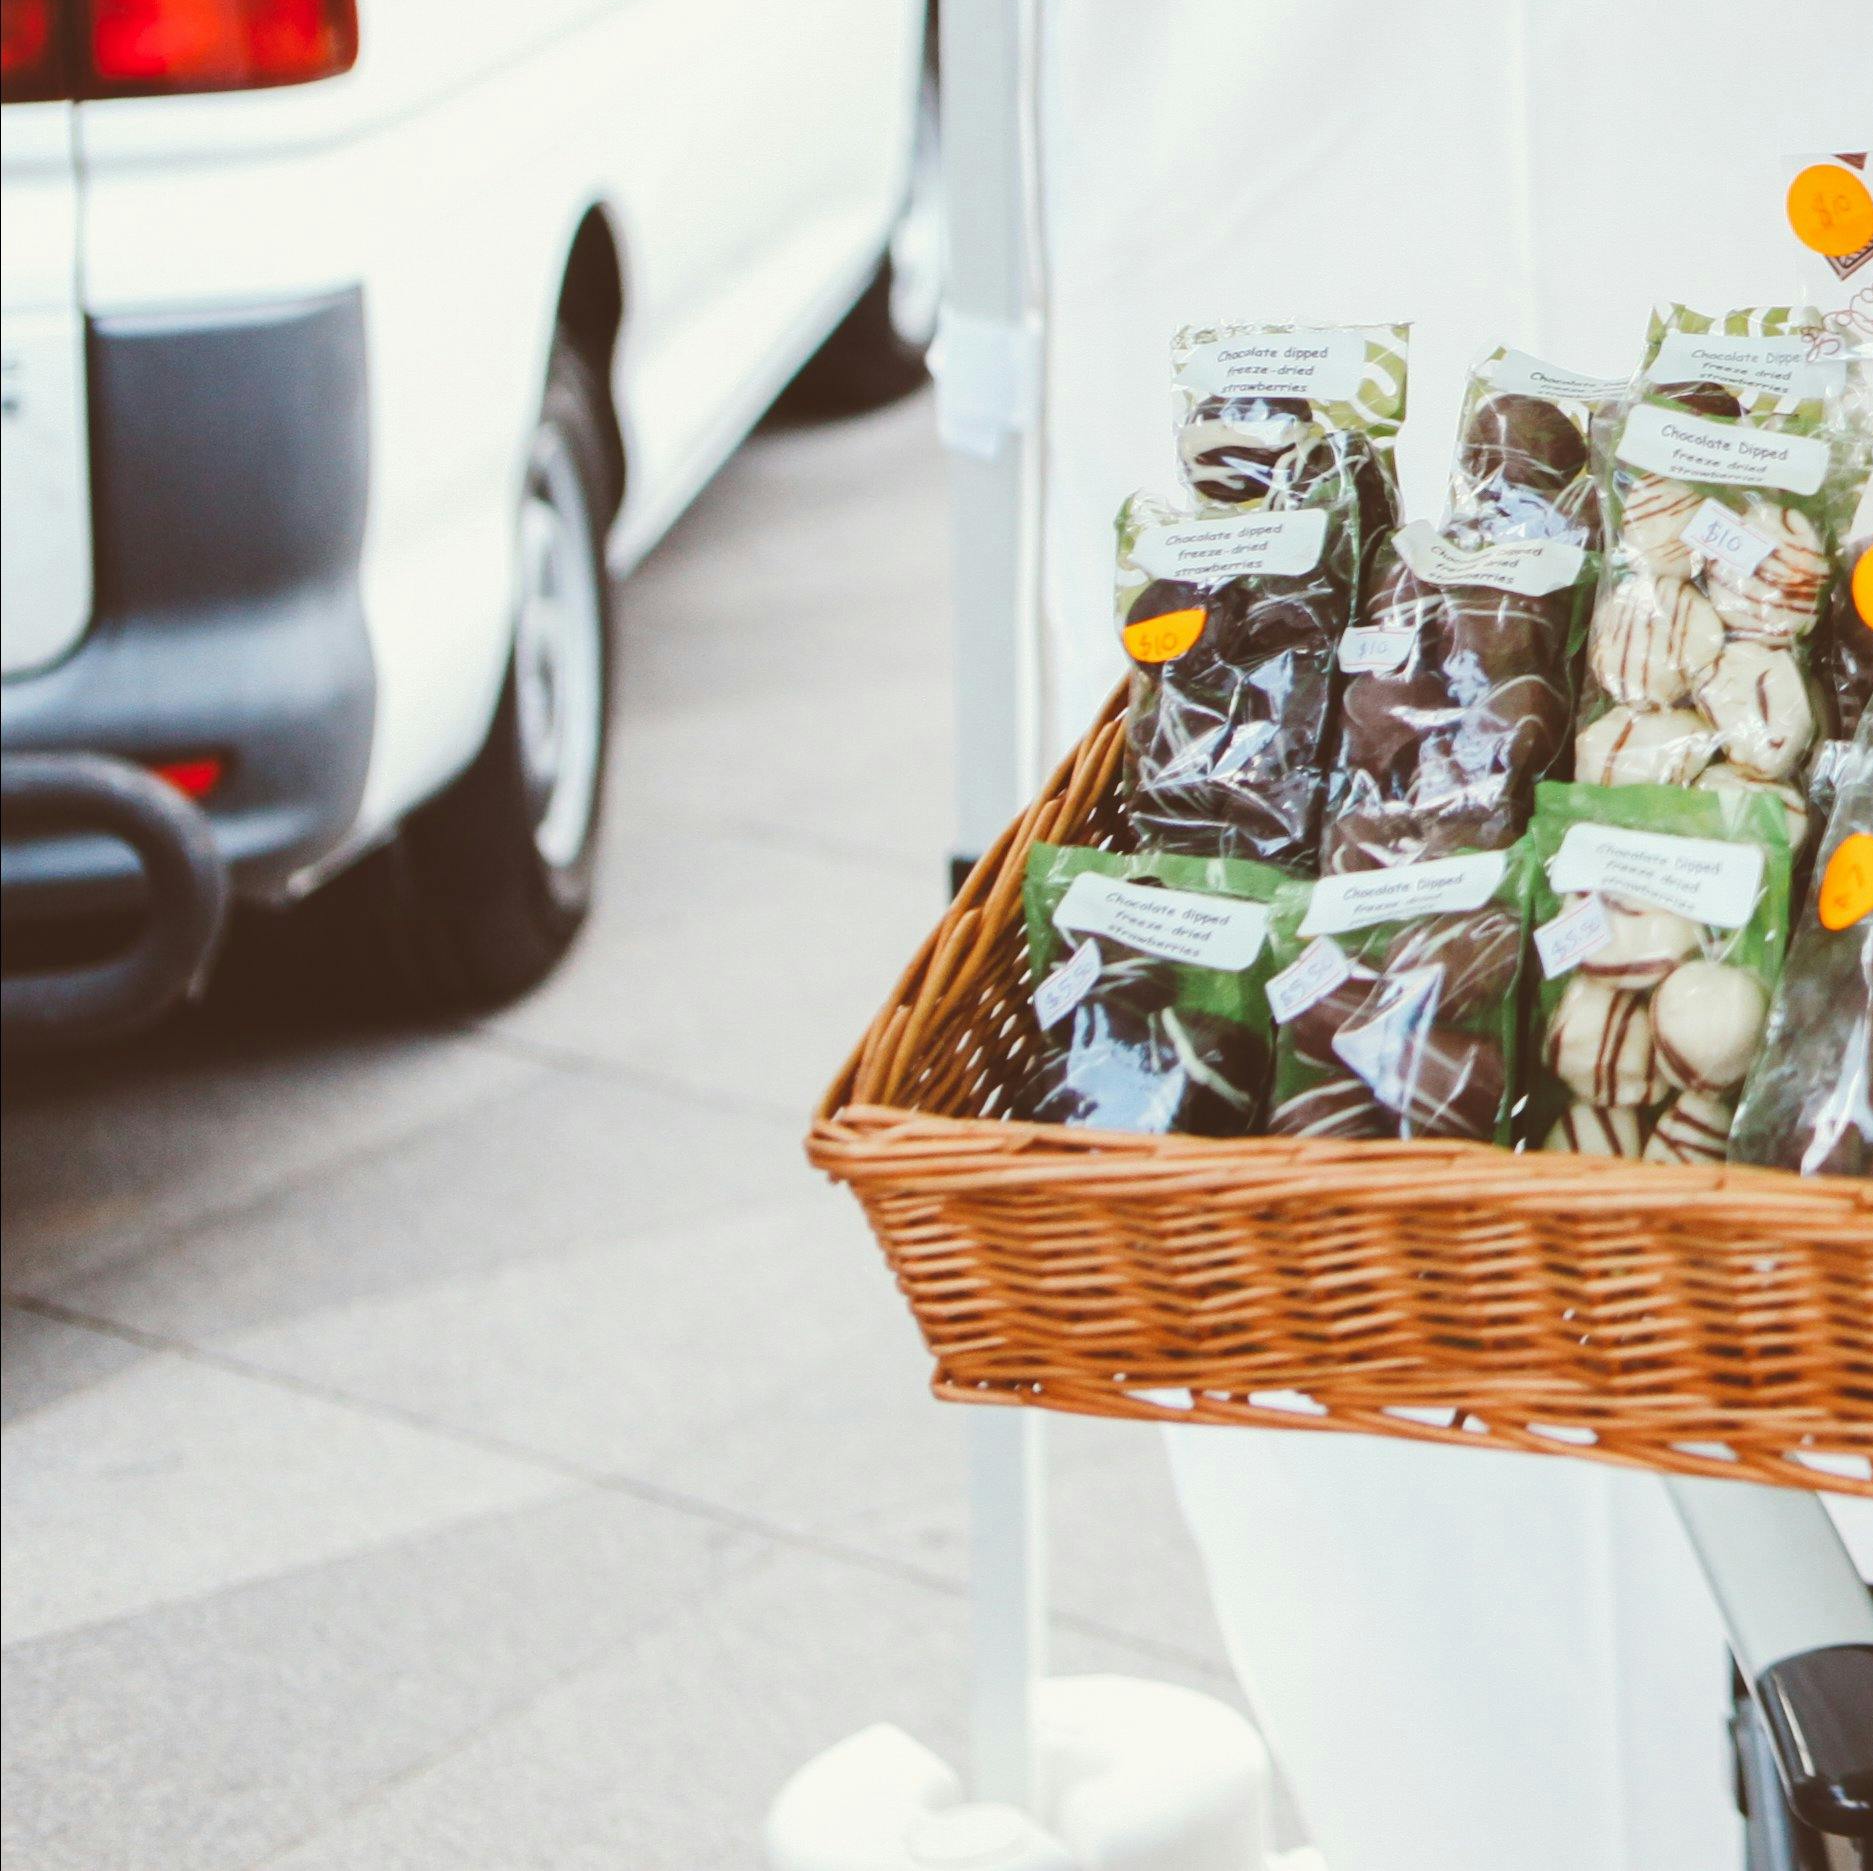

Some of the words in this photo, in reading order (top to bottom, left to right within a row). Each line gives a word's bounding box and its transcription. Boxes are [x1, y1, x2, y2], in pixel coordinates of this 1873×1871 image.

[1216, 347, 1279, 363] Chocolate
[1283, 346, 1330, 360] dipped
[1690, 349, 1760, 364] Chocolate
[1765, 350, 1801, 366] Dippe
[1754, 367, 1794, 382] dried
[1221, 381, 1309, 394] strawberries
[1660, 423, 1731, 452] Chocolate
[1738, 441, 1789, 461] Dipped
[1165, 530, 1232, 546] Chocolate
[1237, 523, 1284, 539] dipped
[1702, 520, 1743, 553] $10
[1173, 559, 1264, 578] strawberries
[1137, 631, 1179, 657] $10
[1103, 891, 1177, 919] Chocolate
[1181, 907, 1232, 927] dipped
